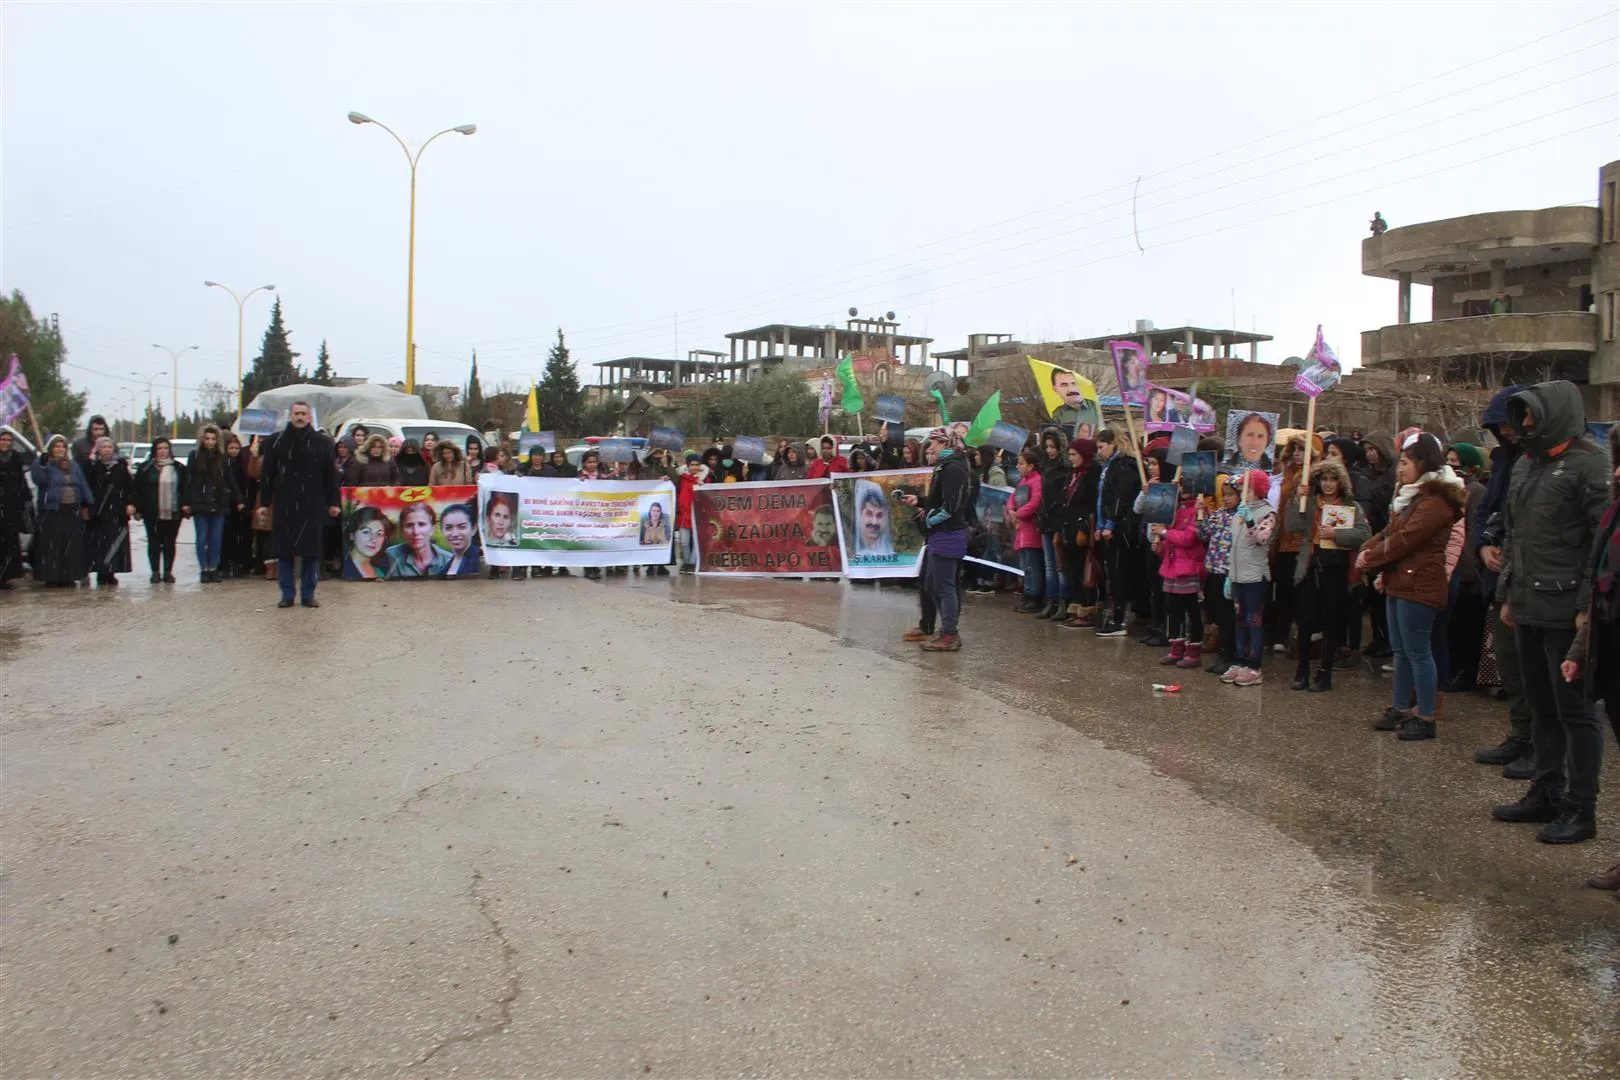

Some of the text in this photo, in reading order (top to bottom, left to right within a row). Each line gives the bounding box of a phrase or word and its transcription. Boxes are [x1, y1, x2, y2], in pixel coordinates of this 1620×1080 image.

[714, 493, 807, 512] DEM DEMA
[765, 551, 800, 568] APO
